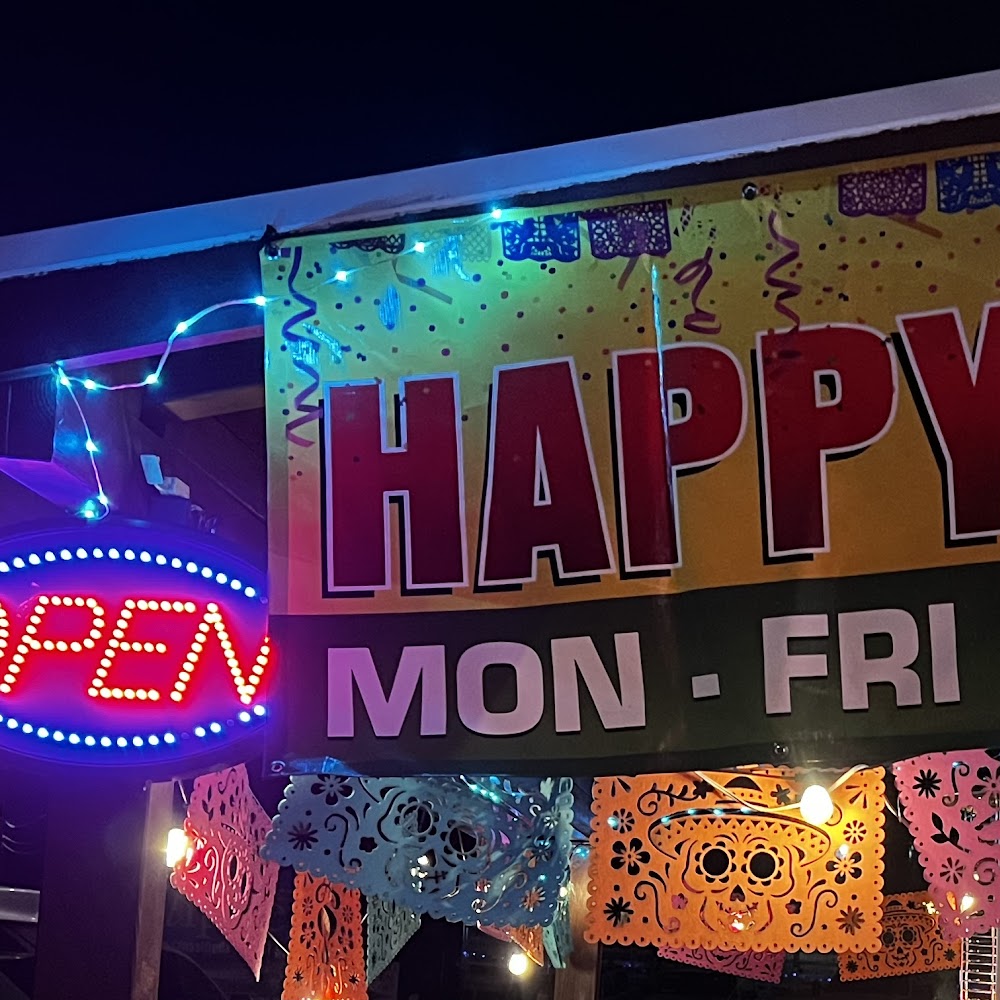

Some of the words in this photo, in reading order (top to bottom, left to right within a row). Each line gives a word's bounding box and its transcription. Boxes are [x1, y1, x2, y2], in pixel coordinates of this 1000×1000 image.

[0, 594, 270, 705] PEN
[326, 630, 647, 739] MON
[691, 672, 722, 700] -
[761, 602, 961, 717] FRI
